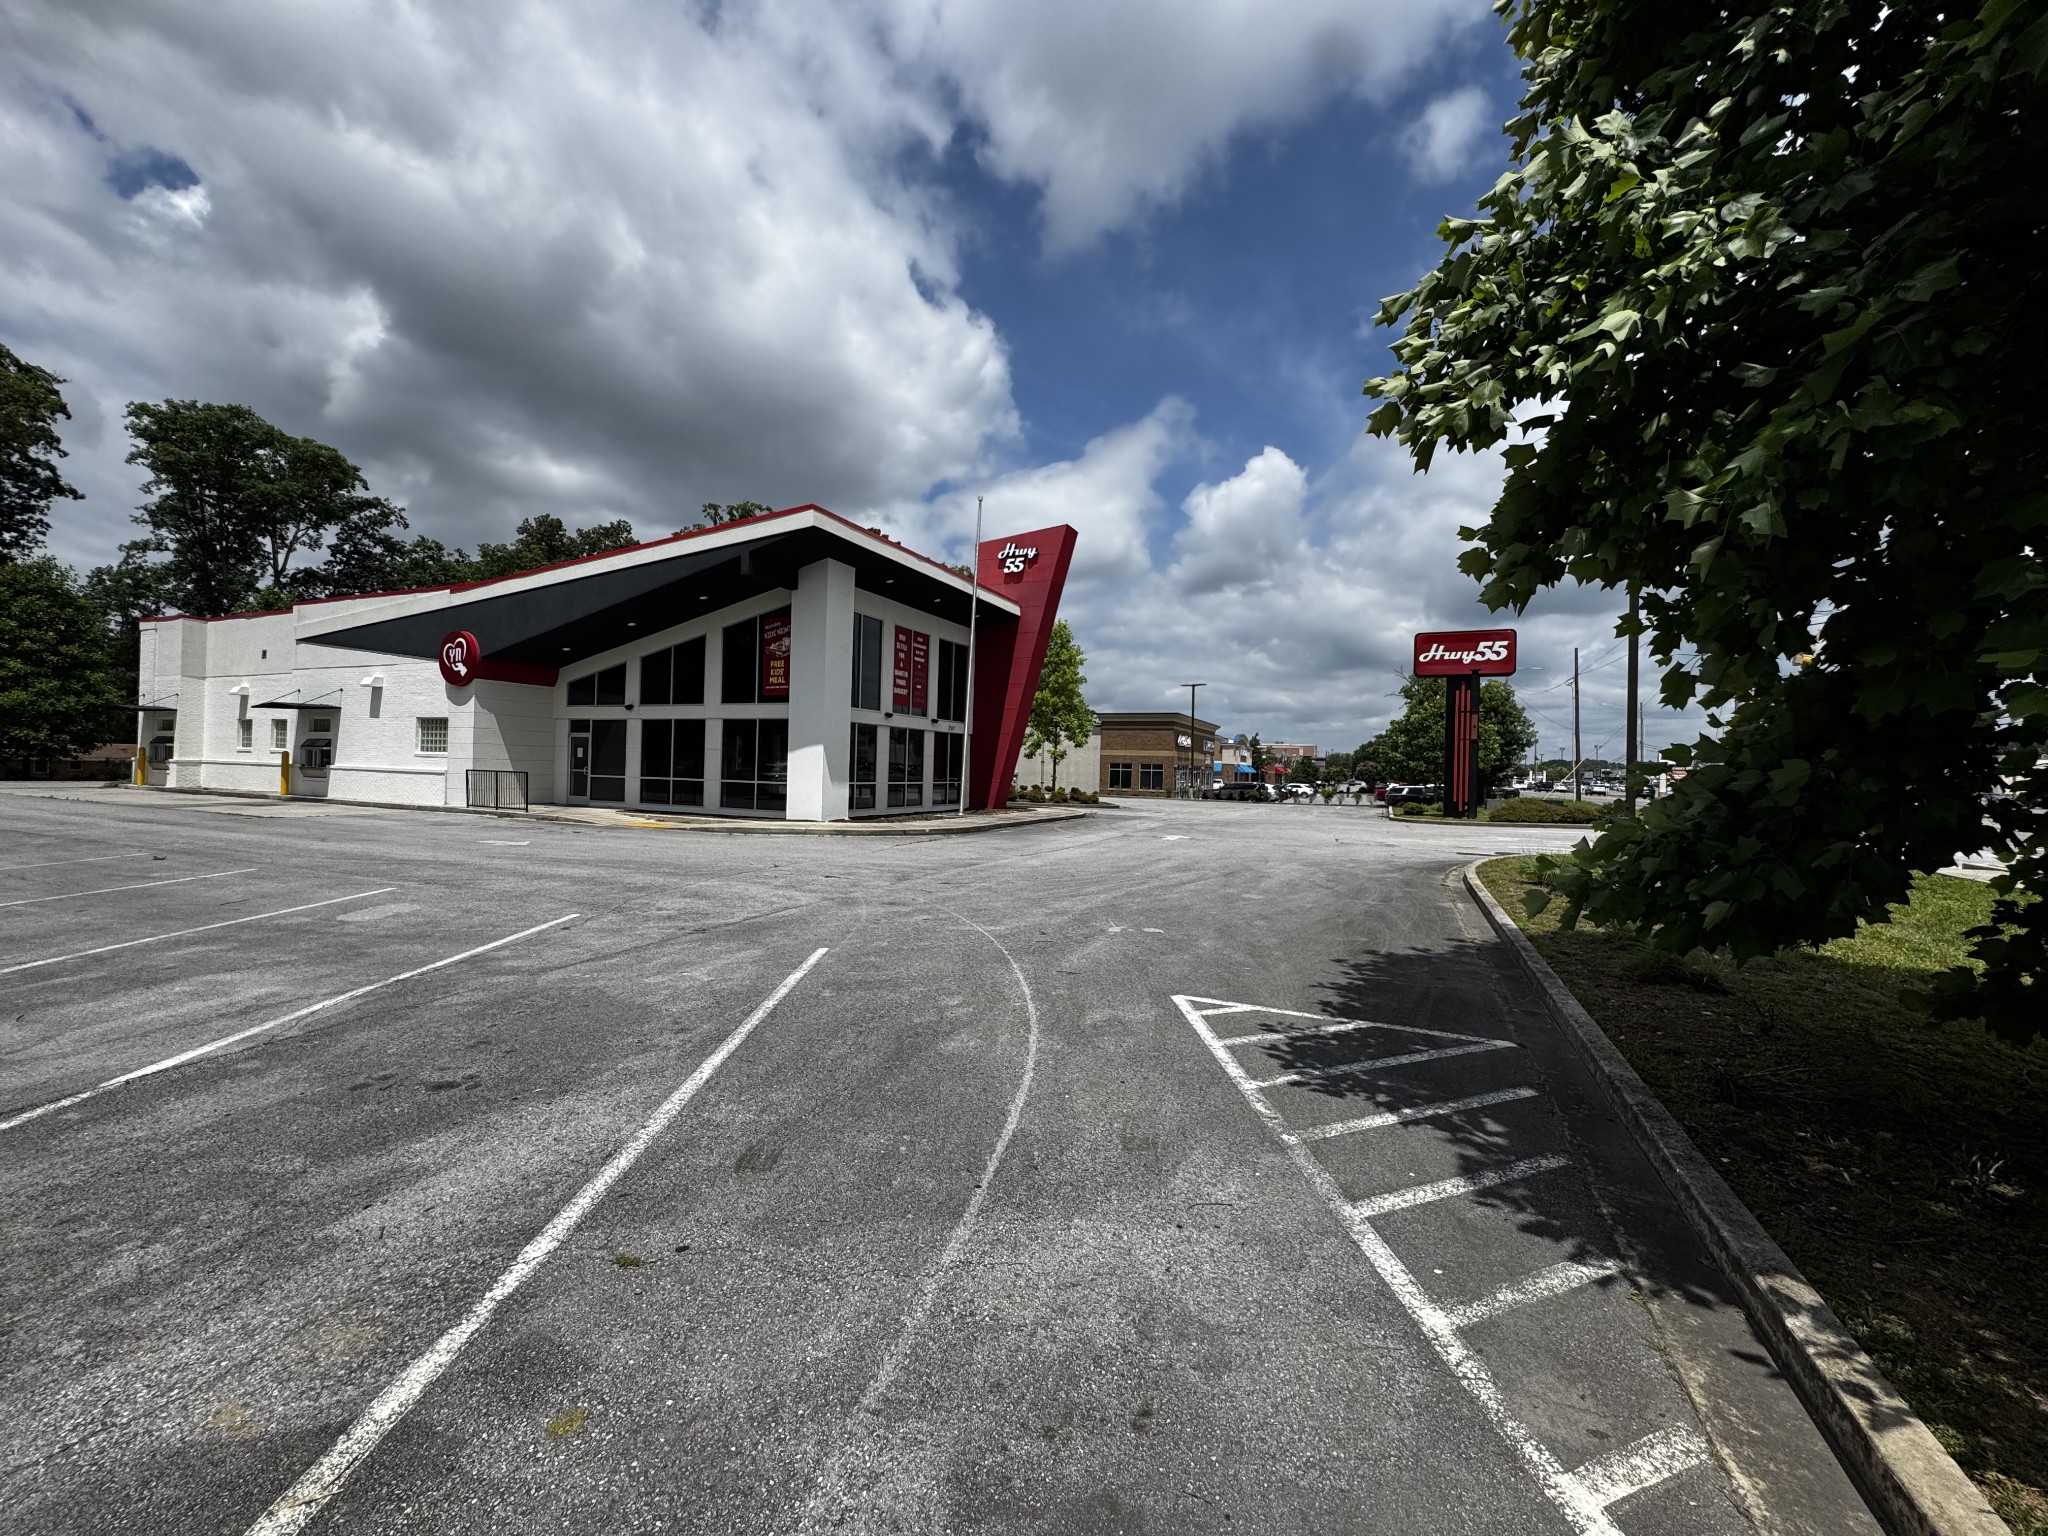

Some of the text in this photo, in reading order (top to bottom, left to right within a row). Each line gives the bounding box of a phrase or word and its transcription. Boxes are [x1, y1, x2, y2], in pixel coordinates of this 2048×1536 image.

[998, 542, 1038, 559] Hwy
[1003, 557, 1025, 574] 55
[770, 660, 785, 668] FREE
[769, 676, 786, 684] MEAL
